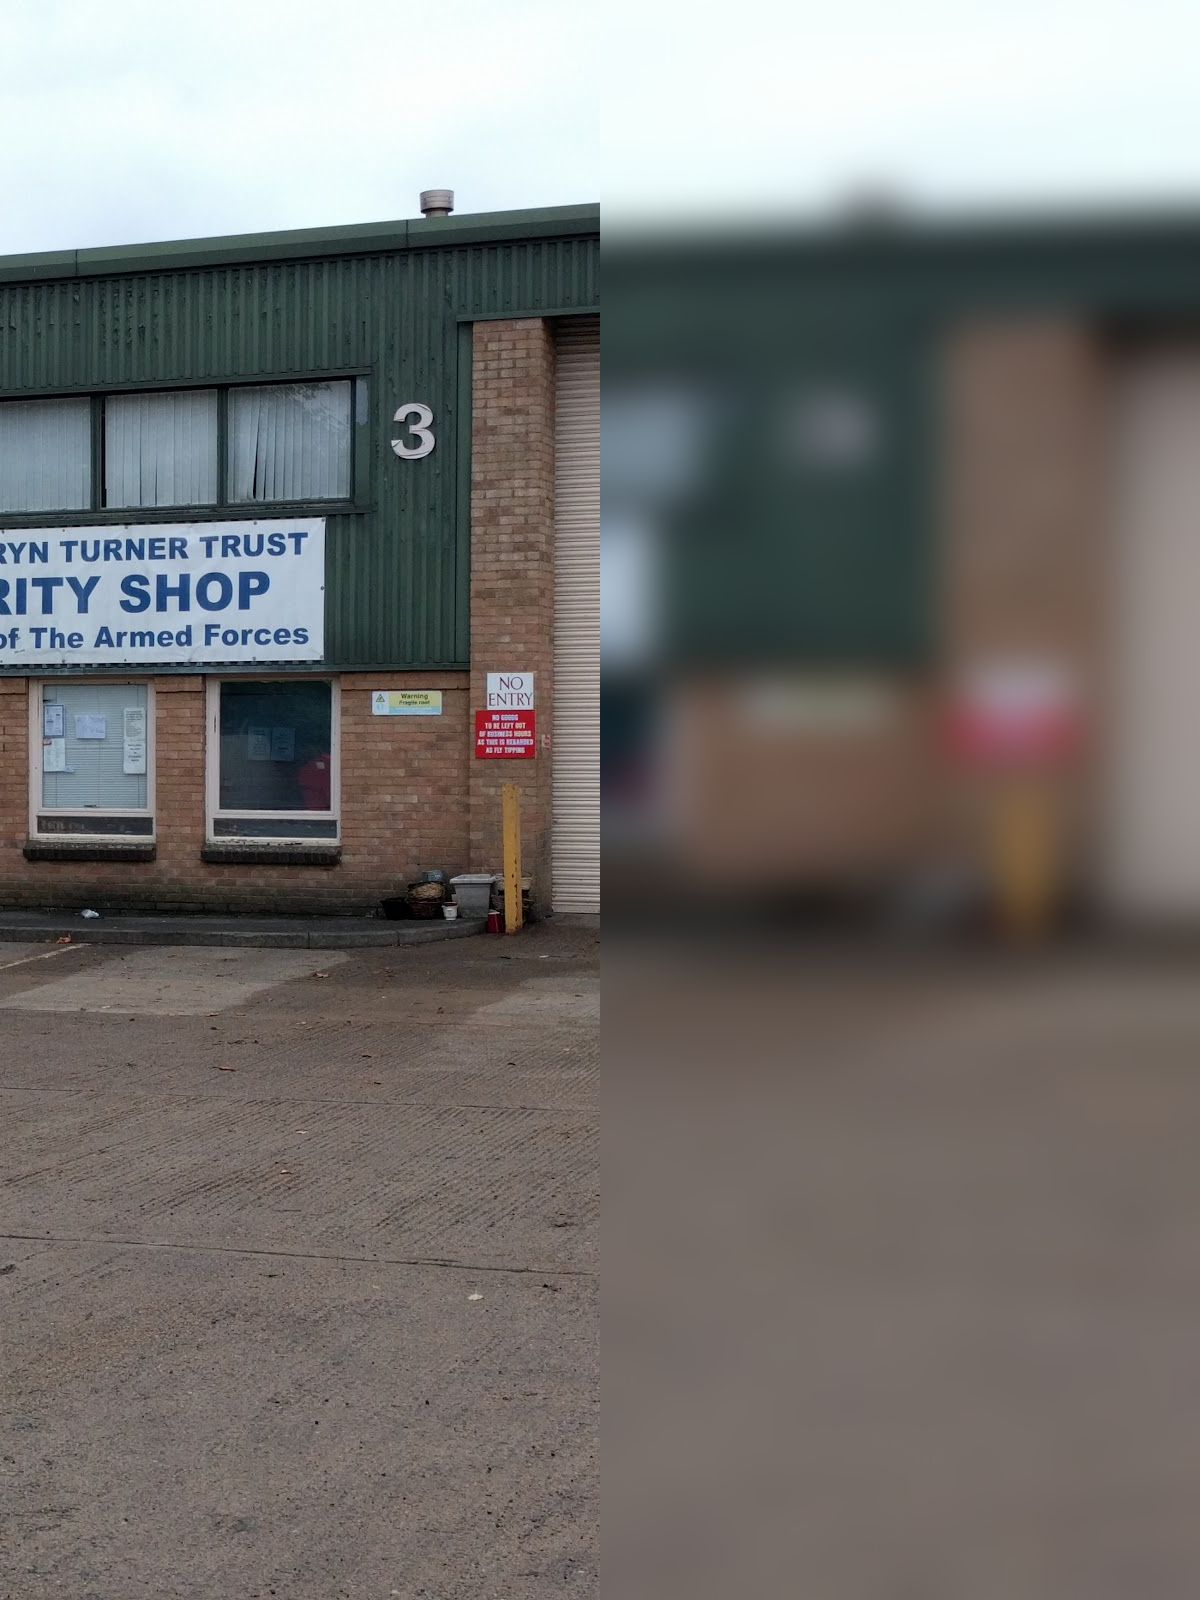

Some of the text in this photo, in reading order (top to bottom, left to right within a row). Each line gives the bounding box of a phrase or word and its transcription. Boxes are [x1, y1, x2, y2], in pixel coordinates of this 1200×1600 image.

[391, 403, 435, 459] 3
[60, 537, 189, 563] TURNER
[200, 532, 308, 558] TRUST
[119, 571, 271, 613] SHOP
[29, 627, 84, 650] The
[94, 625, 192, 648] Armed
[204, 623, 309, 647] Forces
[500, 676, 523, 690] NO
[489, 692, 533, 706] ENTRY
